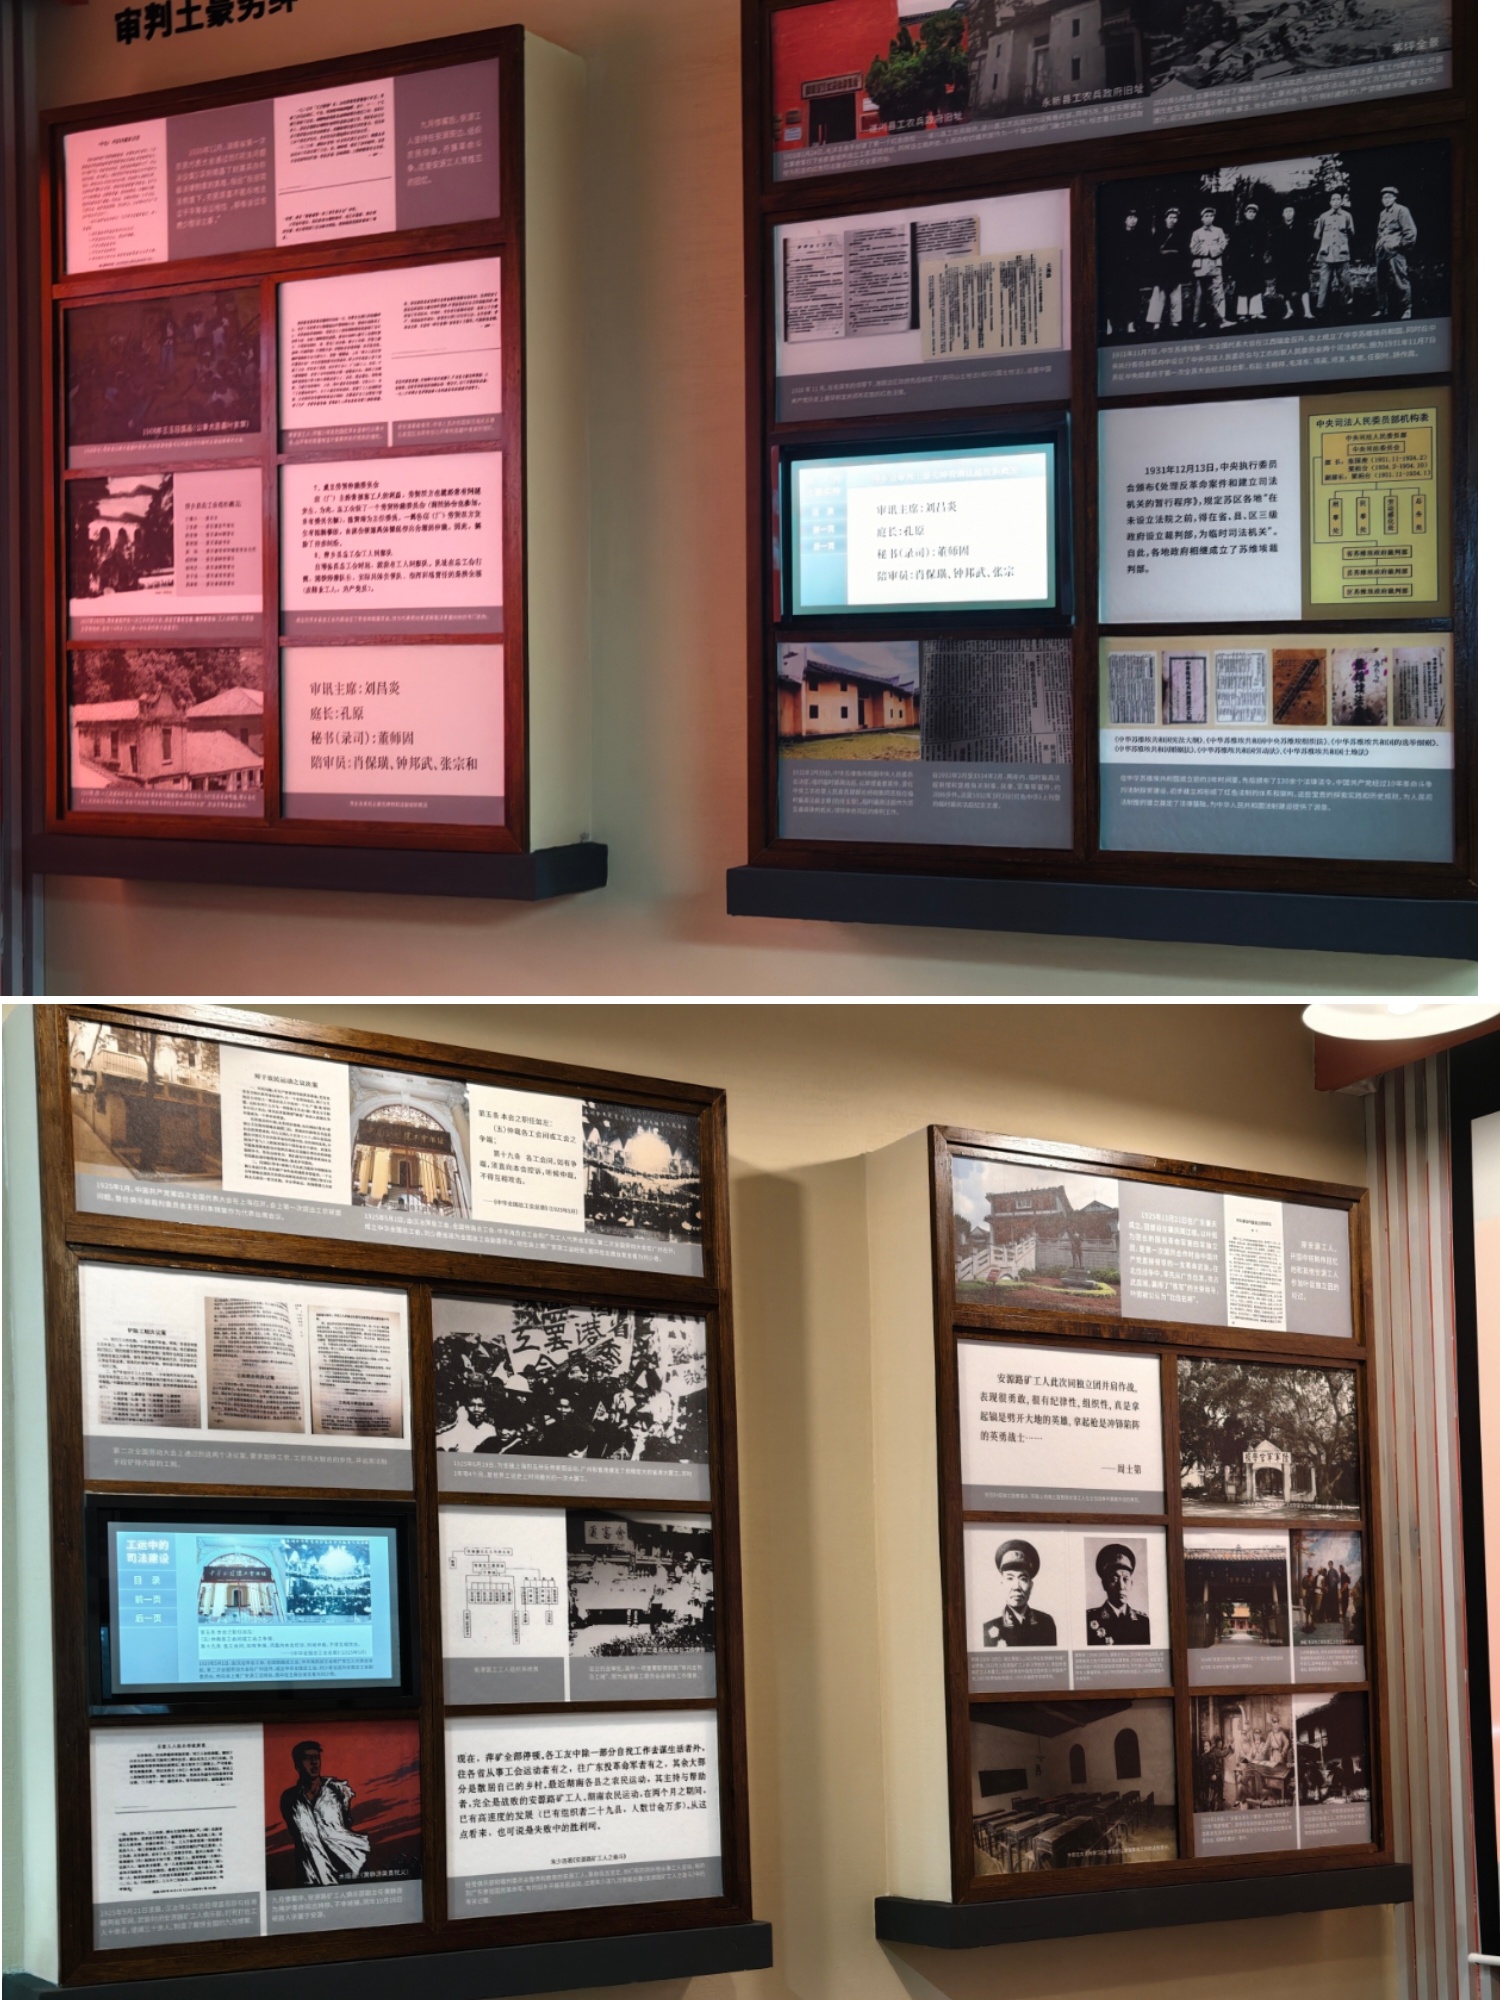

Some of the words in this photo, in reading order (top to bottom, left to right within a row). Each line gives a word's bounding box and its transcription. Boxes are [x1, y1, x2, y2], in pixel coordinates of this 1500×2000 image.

[1041, 84, 1144, 108] 永新县工农兵政府旧址
[1316, 413, 1430, 428] 中央司法人民委员部机构表
[1144, 459, 1278, 476] 1931年12月13日，中央执行委员
[1126, 476, 1278, 493] 会颁布《处理反革命案件和建立司法
[1126, 510, 1279, 526] 未设立法院之前，得在省、县、区三级
[876, 524, 926, 538] 庭长：孔原
[1126, 526, 1279, 542] 政府设立裁判部，为临时司法机关”。
[1127, 543, 1279, 558] 自此，各地政府相继成立了苏维埃裁
[1127, 564, 1150, 574] 判部。
[309, 706, 365, 721] 庭长：孔原
[979, 1391, 1140, 1411] 表现很勇敢，很有纪律性，组织性，真是拿
[979, 1410, 1141, 1431] 起镐是劈开大地的英雄，拿起枪是冲锋陷阵
[125, 1539, 169, 1552] 工运中的
[126, 1553, 170, 1565] 司法建设
[134, 1595, 161, 1605] 前一页
[135, 1613, 162, 1624] 后一页
